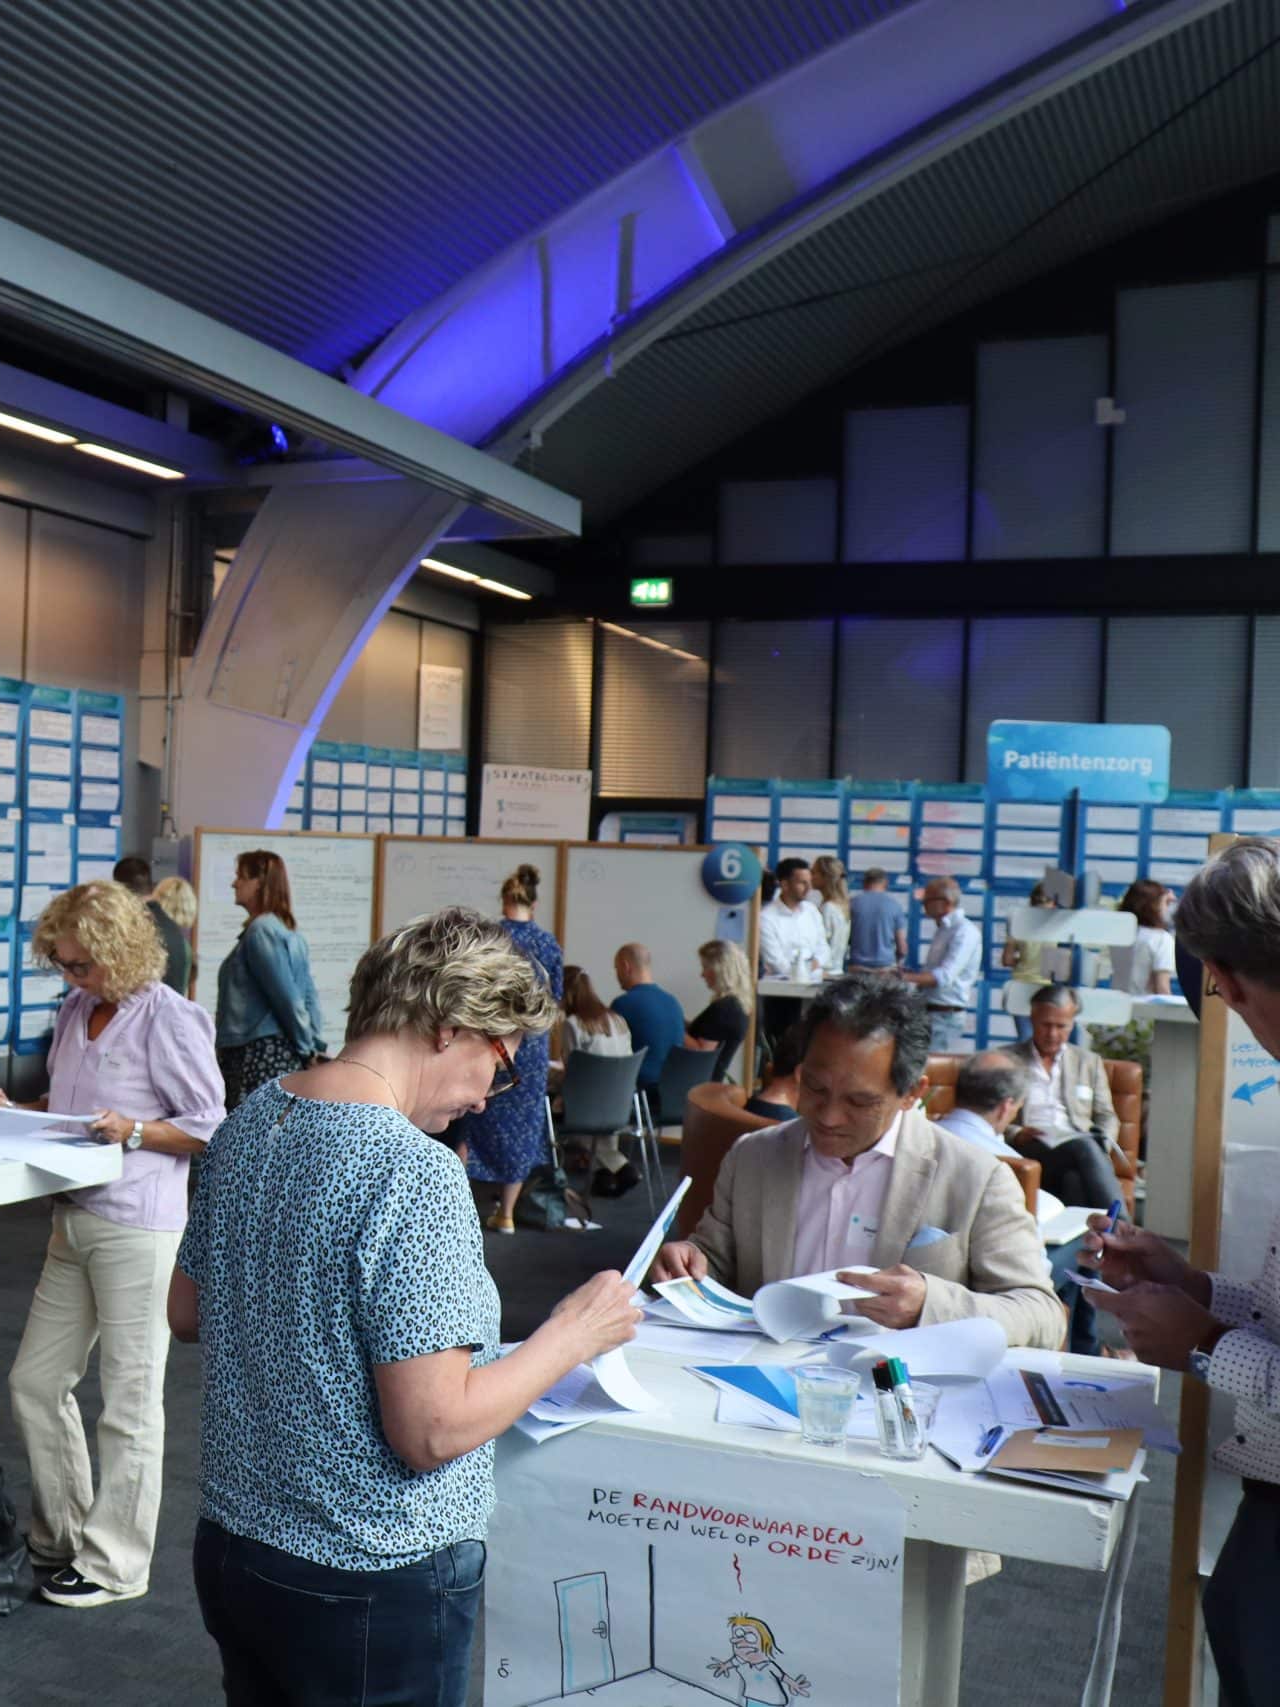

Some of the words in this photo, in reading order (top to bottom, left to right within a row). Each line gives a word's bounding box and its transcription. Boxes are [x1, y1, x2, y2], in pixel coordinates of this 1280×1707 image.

[1003, 750, 1153, 775] Patiëntenzorg
[721, 849, 741, 879] 6
[588, 1509, 679, 1531] MOETEN
[691, 1524, 729, 1540] WEL
[735, 1533, 760, 1547] OP
[768, 1541, 845, 1564] ORDE
[593, 1488, 622, 1504] DE
[633, 1493, 863, 1546] RANDVOORWAARDEN
